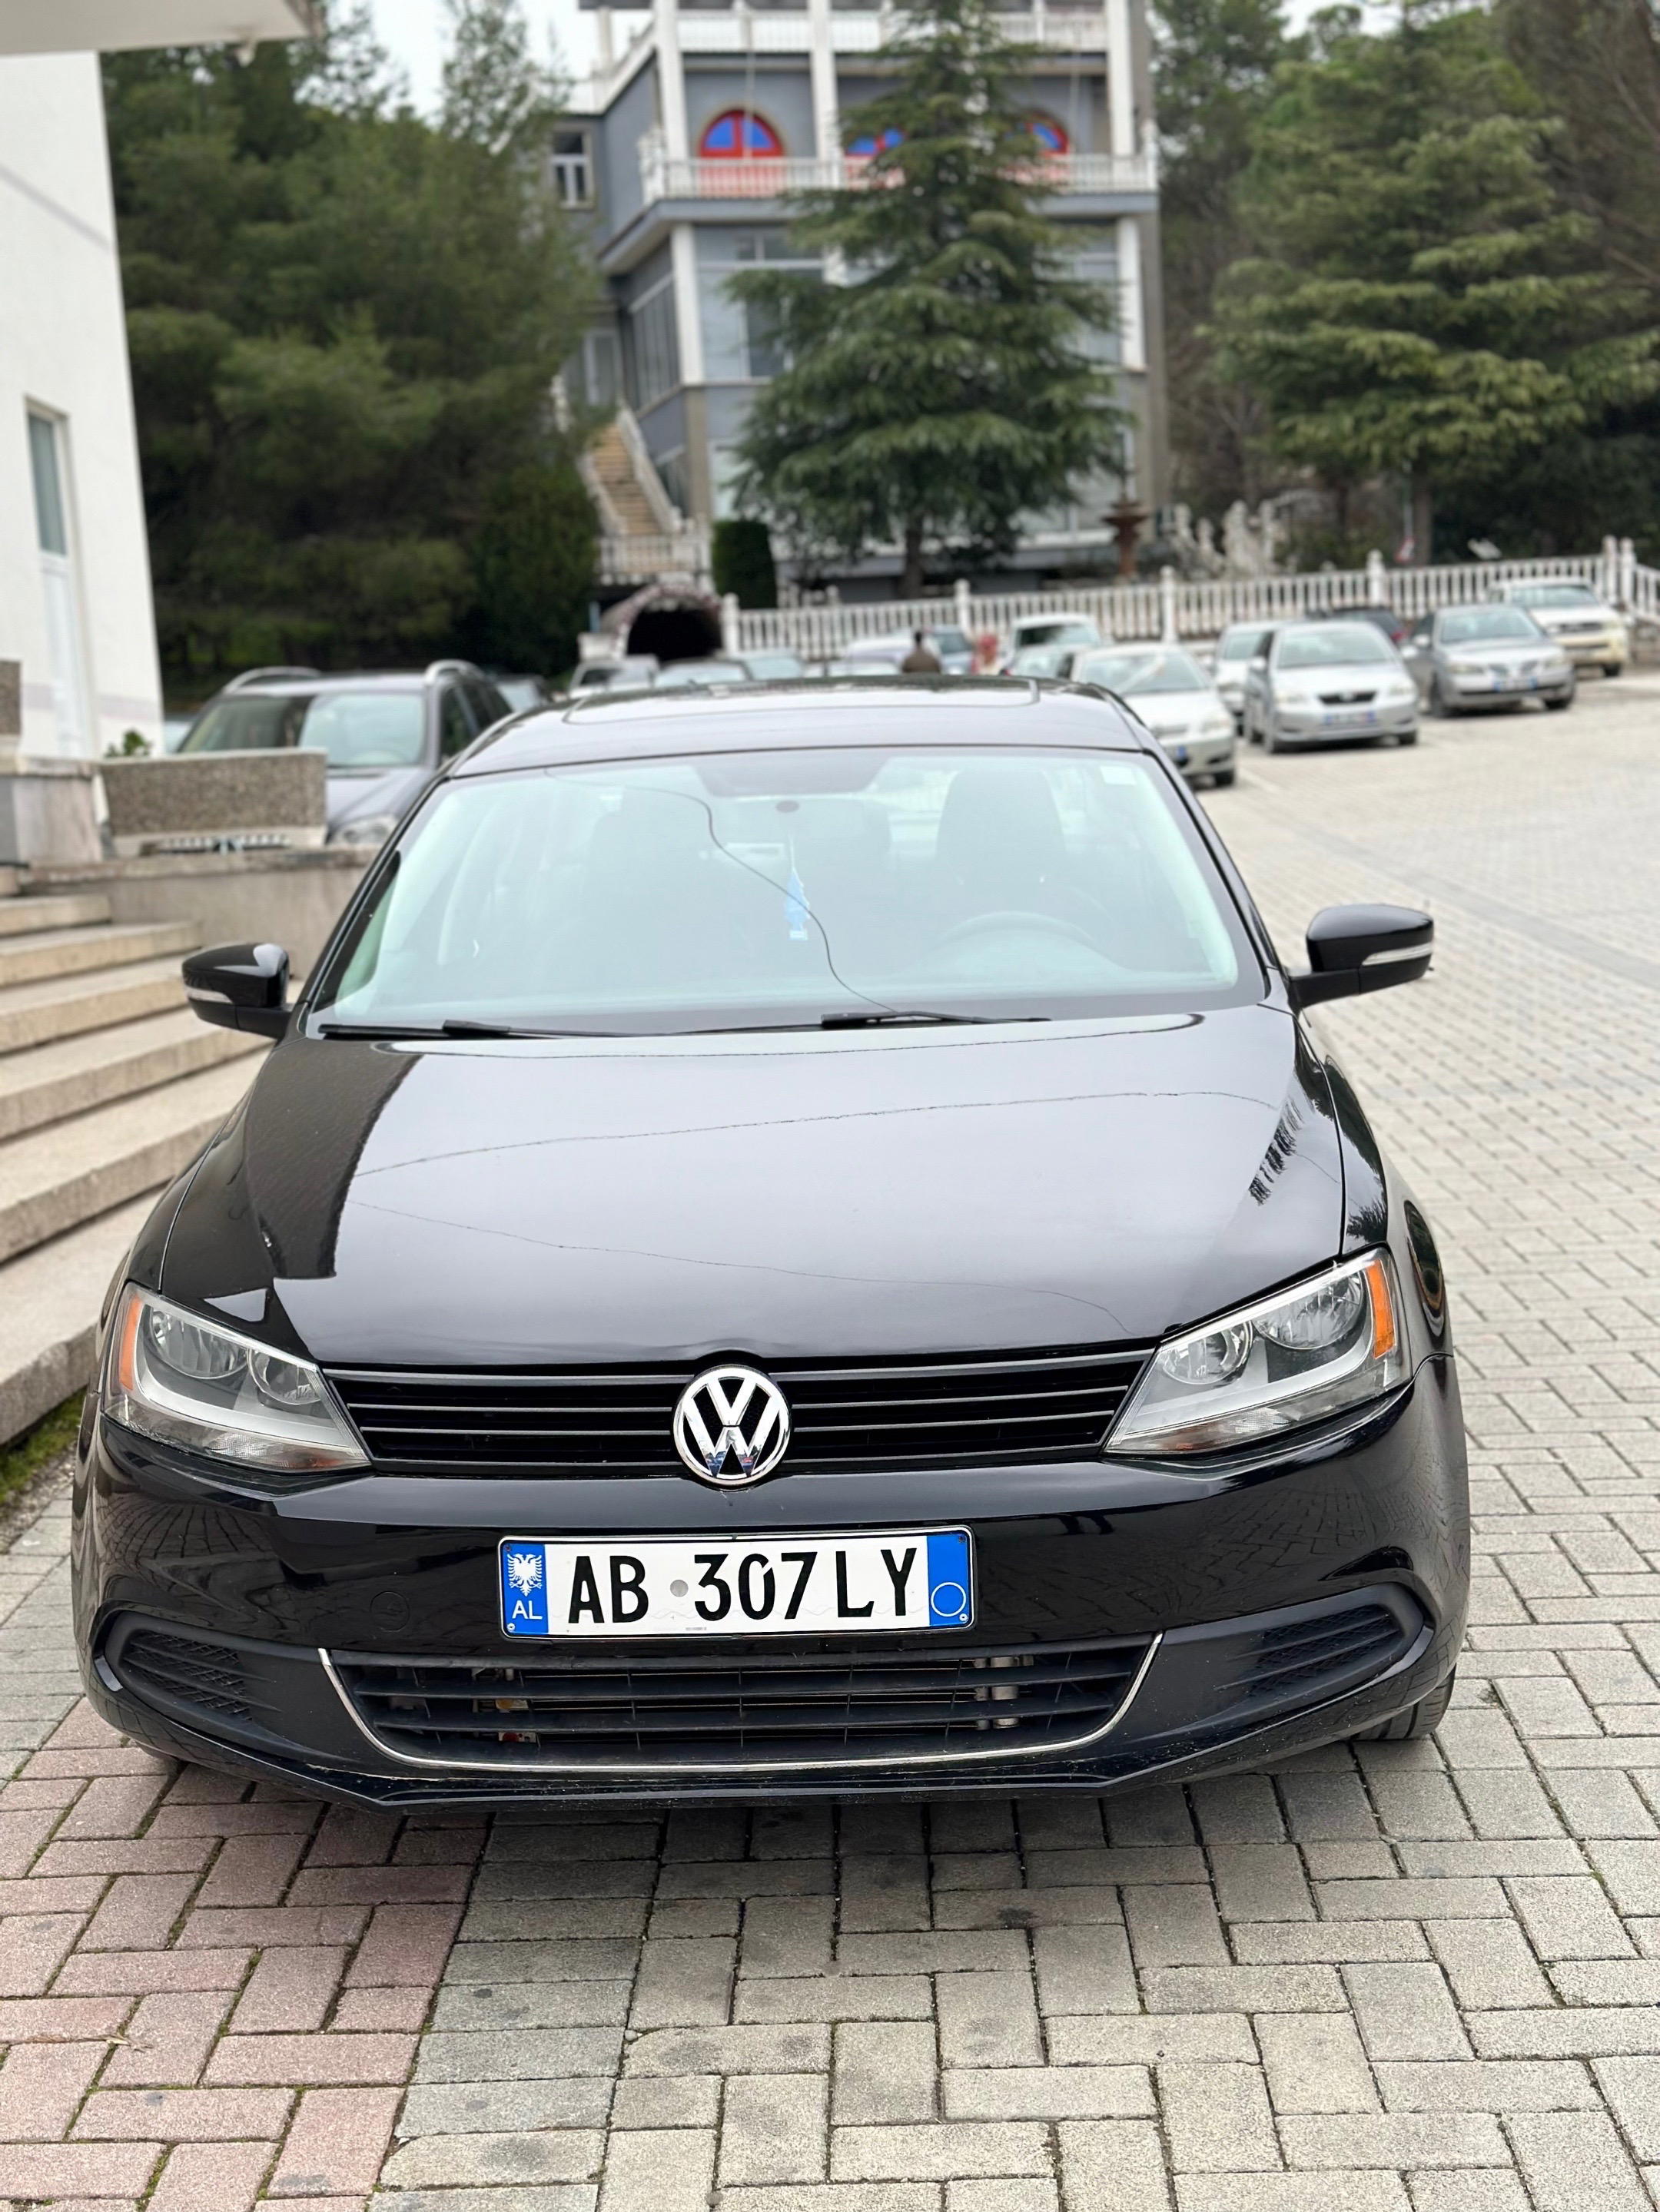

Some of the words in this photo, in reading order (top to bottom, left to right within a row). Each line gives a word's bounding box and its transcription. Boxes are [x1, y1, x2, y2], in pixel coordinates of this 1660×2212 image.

[676, 1369, 788, 1481] VW
[511, 1600, 543, 1620] AL
[568, 1554, 649, 1623] AB
